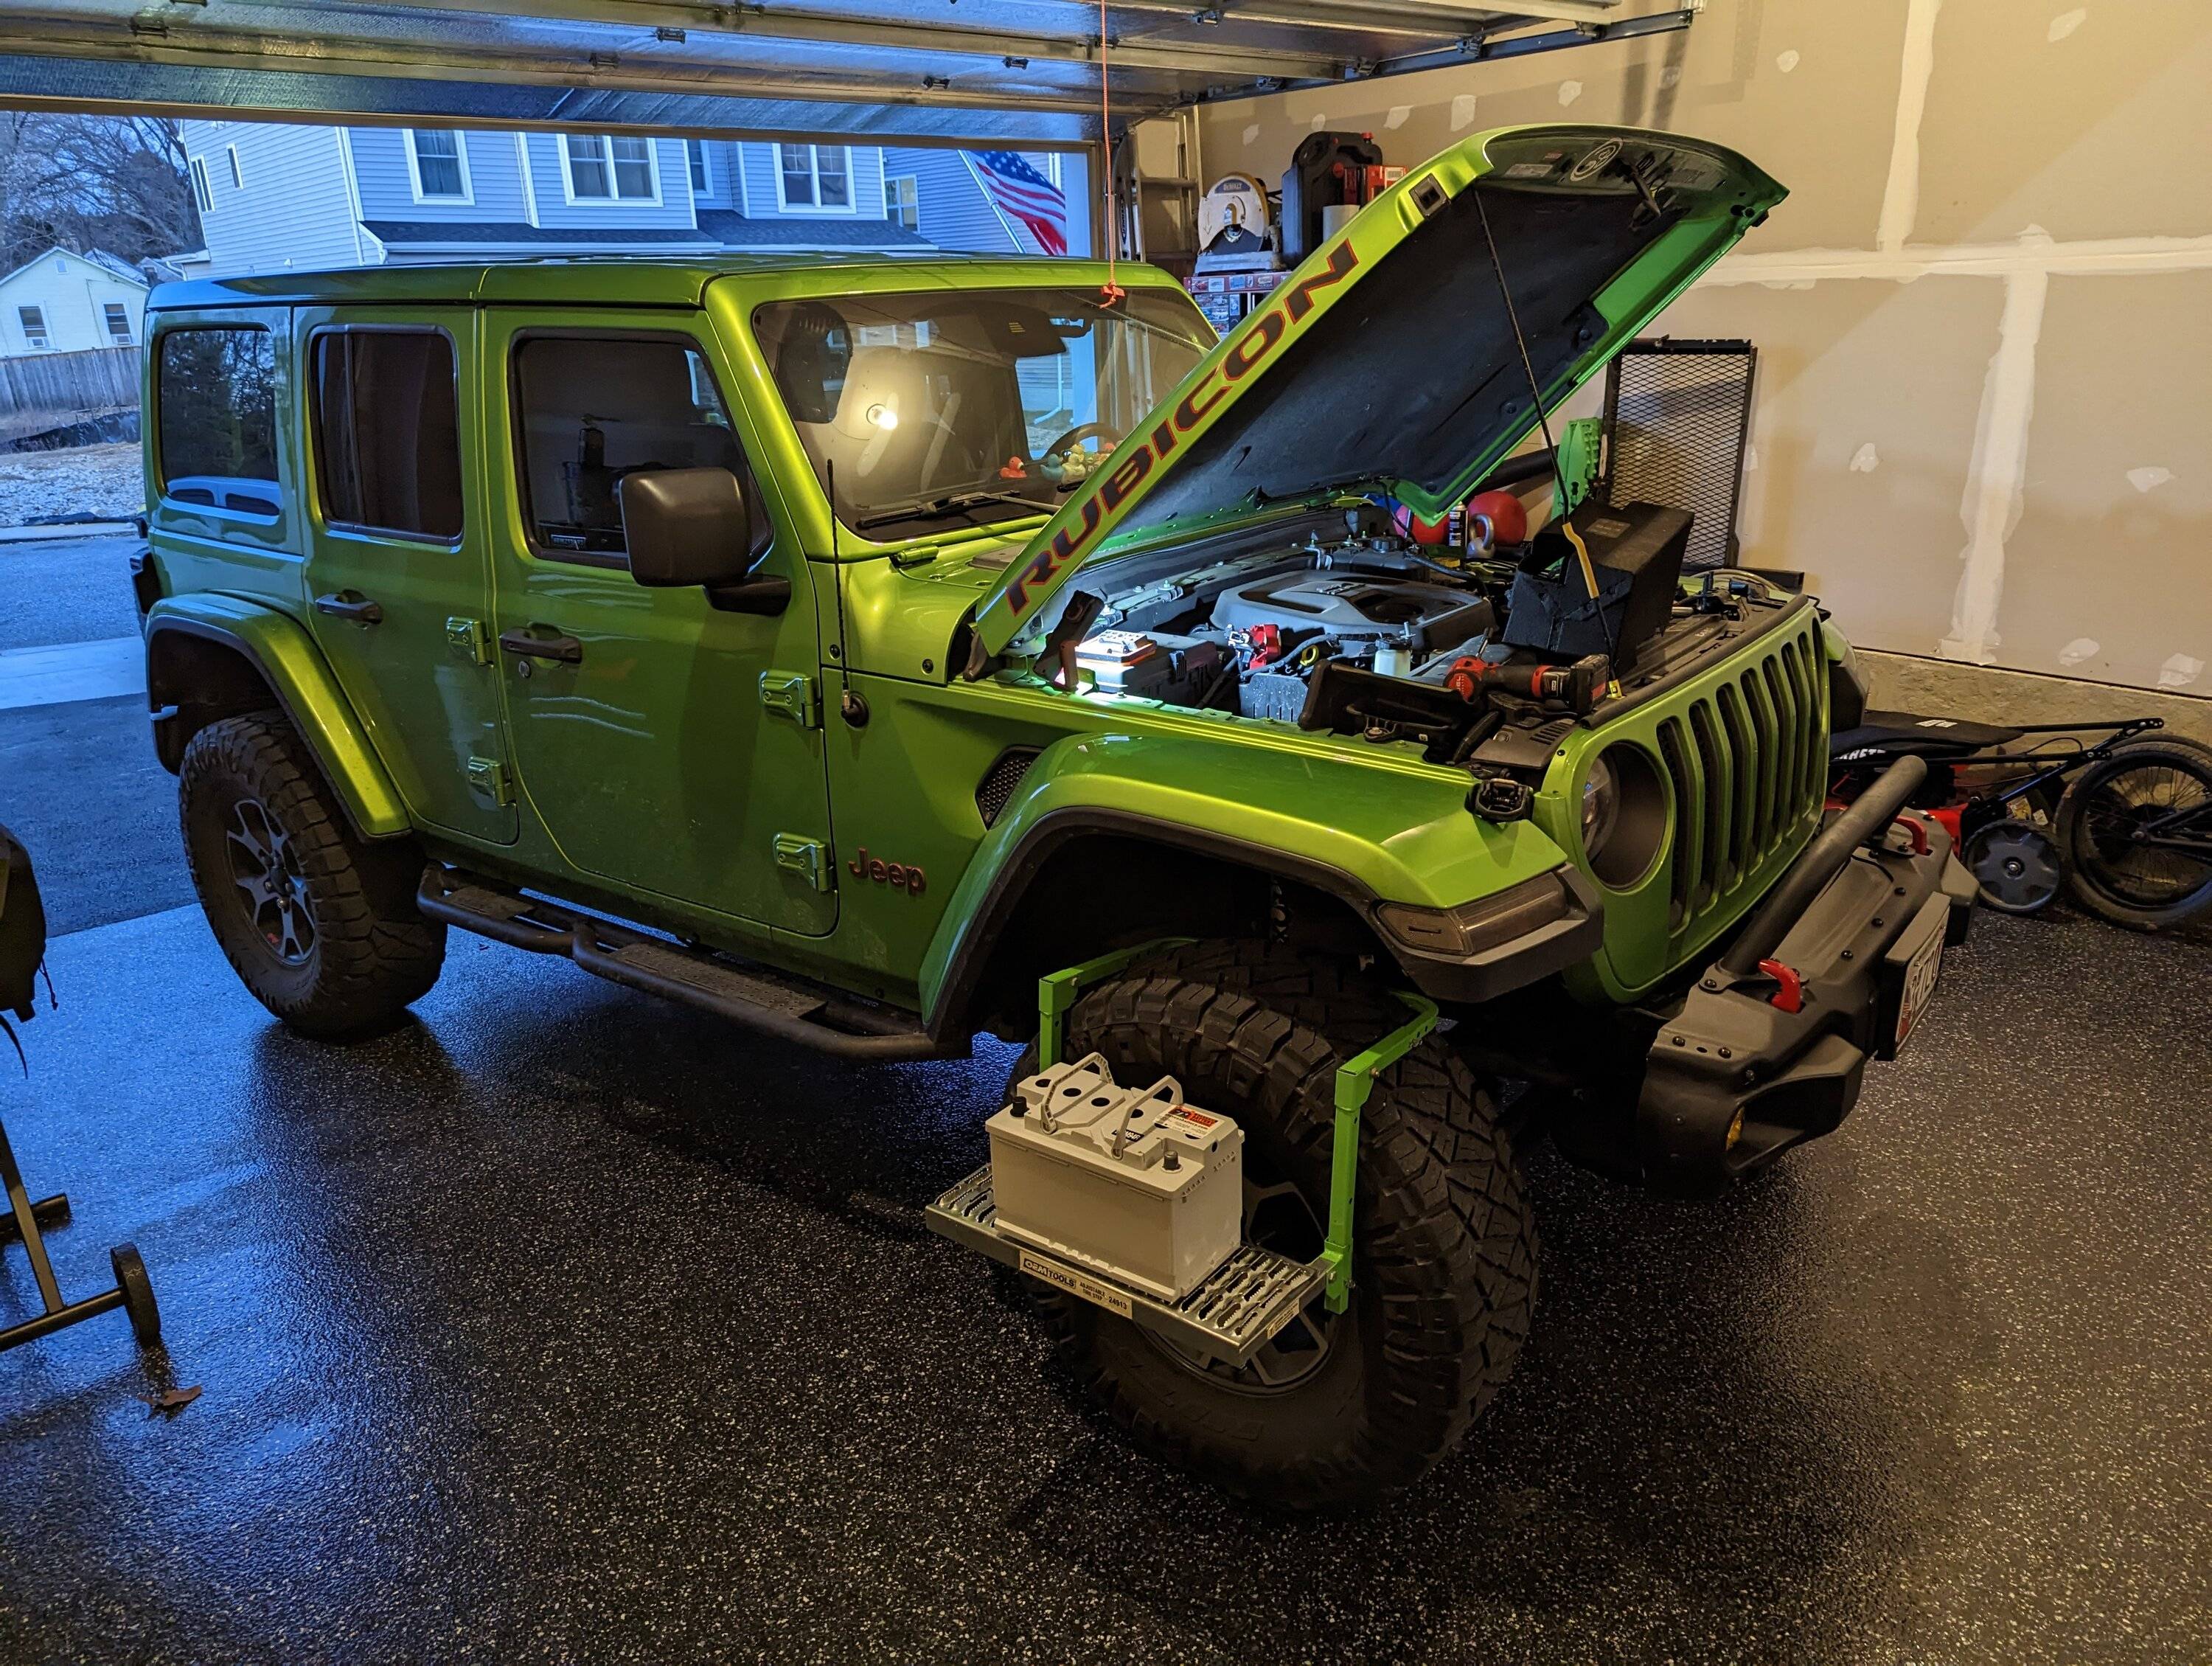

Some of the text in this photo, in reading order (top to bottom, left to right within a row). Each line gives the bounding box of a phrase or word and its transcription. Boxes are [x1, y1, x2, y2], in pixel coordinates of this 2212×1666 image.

[1004, 237, 1360, 617] RUBICON
[848, 847, 927, 896] Jeep
[1108, 1296, 1127, 1311] 24913
